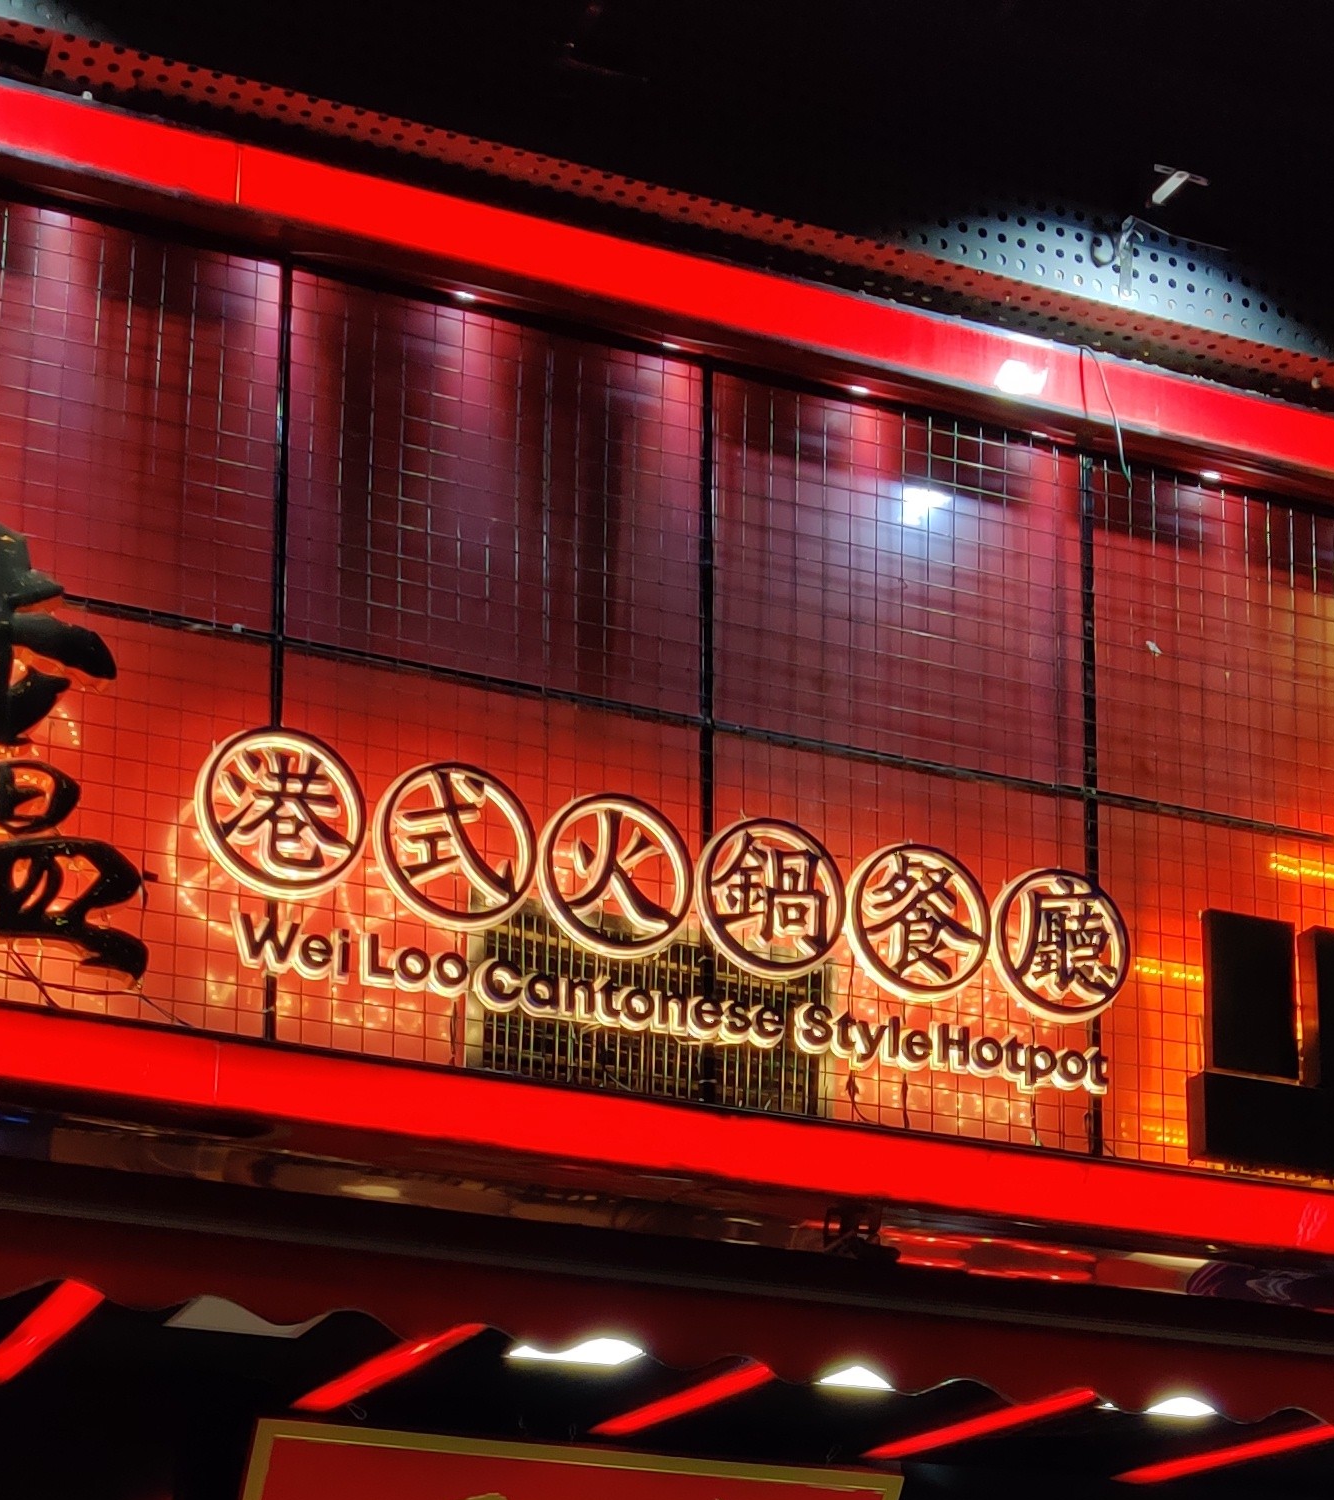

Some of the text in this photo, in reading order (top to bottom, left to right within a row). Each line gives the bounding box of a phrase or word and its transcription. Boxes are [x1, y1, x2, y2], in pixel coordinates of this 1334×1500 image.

[202, 733, 1127, 1016] 港式火鍋餐廳
[231, 910, 350, 985] Wei
[359, 930, 468, 999] Loo
[474, 956, 785, 1047] Cantonese
